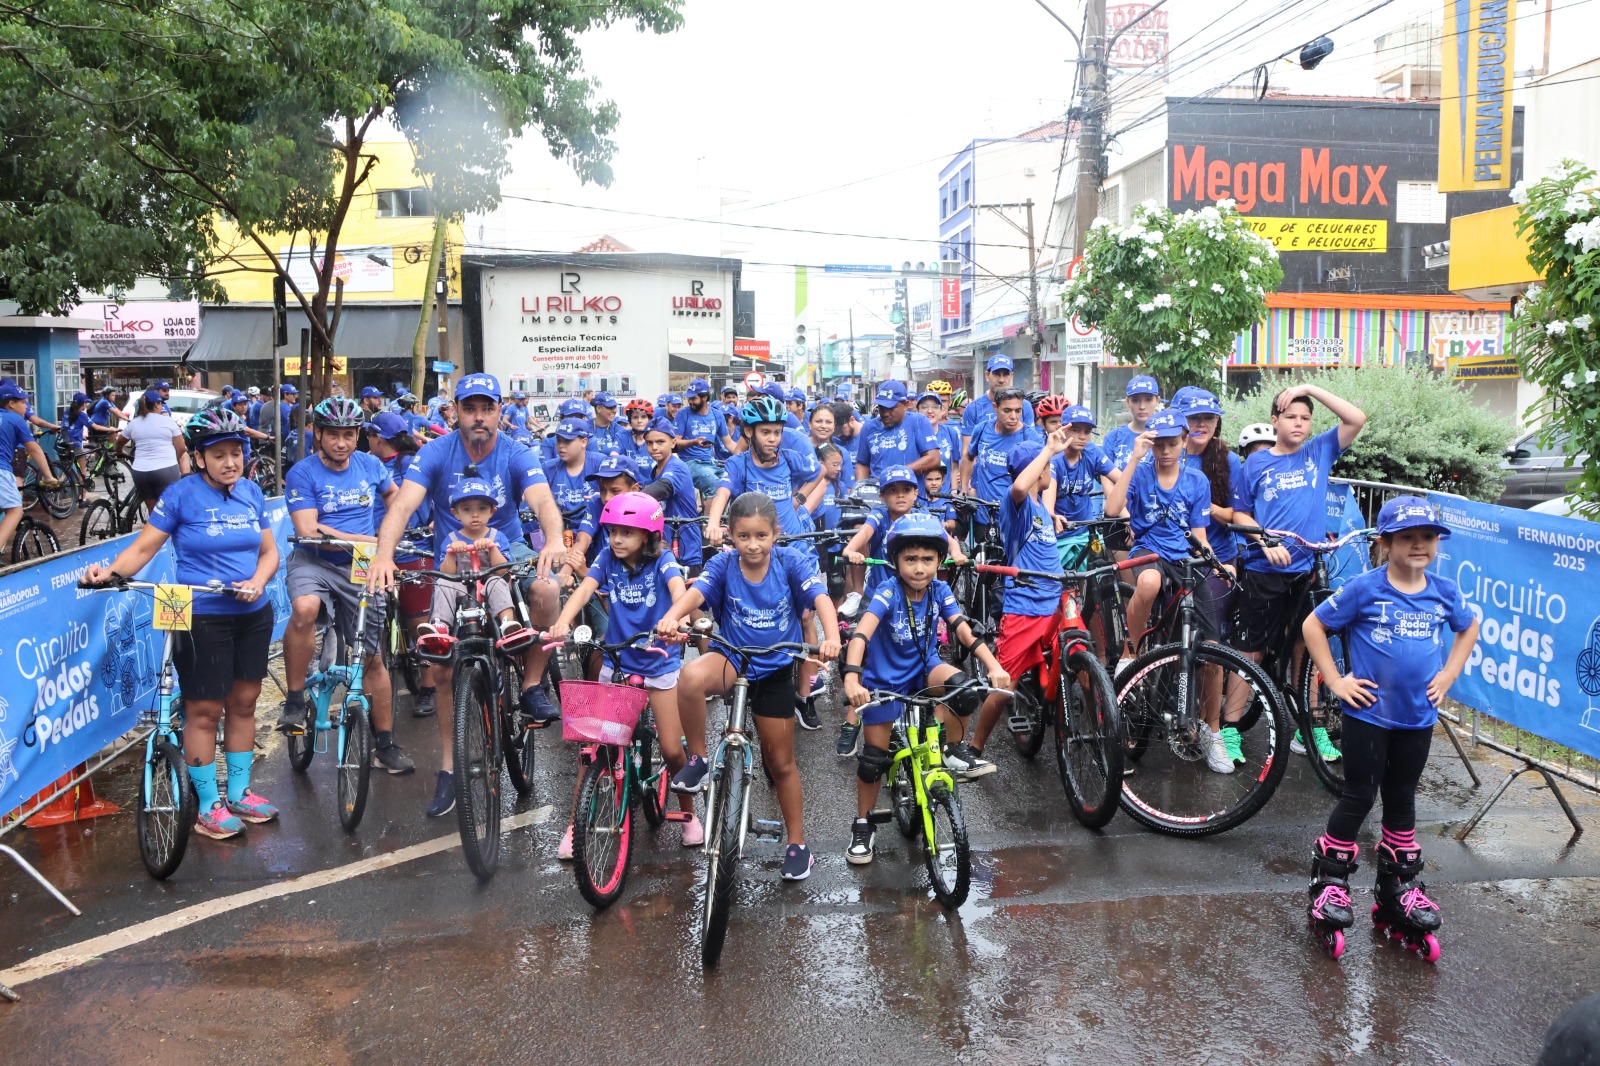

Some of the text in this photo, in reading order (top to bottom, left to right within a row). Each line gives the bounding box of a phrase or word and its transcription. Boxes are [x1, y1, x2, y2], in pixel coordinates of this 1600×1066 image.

[1174, 144, 1388, 212] Mega Max
[1280, 222, 1298, 233] DE
[1306, 223, 1378, 234] CELULARES
[1292, 236, 1299, 246] E
[1308, 237, 1376, 248] PELICULAS
[163, 318, 196, 326] LOJA DE
[522, 316, 618, 324] IMPORTS
[165, 328, 196, 336] R$10,00
[522, 334, 576, 342] Assistência
[538, 345, 602, 353] Especializada
[1435, 339, 1496, 357] TOYS
[1275, 469, 1305, 479] Circuito
[1282, 481, 1308, 490] Pedais
[1443, 506, 1461, 515] PREFEITURA
[1443, 513, 1500, 532] FERNANDÓPOLIS
[1553, 552, 1586, 571] 2025
[1456, 560, 1566, 624] Circuito
[742, 606, 775, 615] Circuito
[1394, 610, 1433, 620] Circuito
[1400, 620, 1430, 628] Rodas
[1400, 628, 1431, 636] Pedais
[1468, 602, 1554, 663] Rodas
[15, 620, 89, 680] Circuito
[1464, 644, 1560, 708] Pedais
[33, 661, 92, 714] Rodas
[1178, 672, 1188, 714] VORTEX
[36, 692, 99, 754] Pedais
